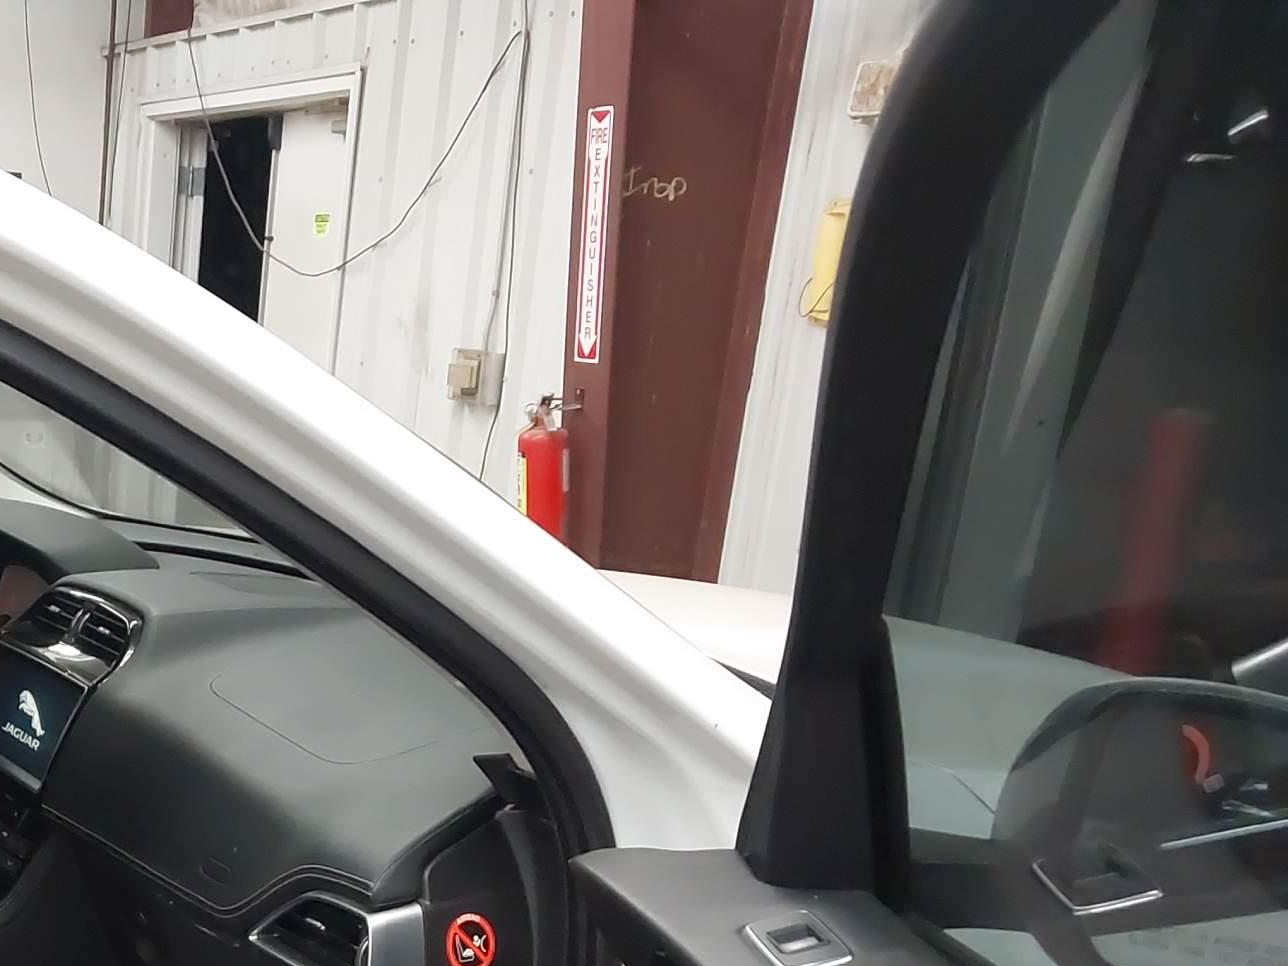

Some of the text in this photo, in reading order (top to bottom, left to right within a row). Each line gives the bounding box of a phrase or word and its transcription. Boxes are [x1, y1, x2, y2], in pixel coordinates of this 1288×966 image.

[590, 127, 609, 144] FIRE
[584, 147, 602, 340] EXTINGUISHER
[1, 721, 41, 752] JAGUAR
